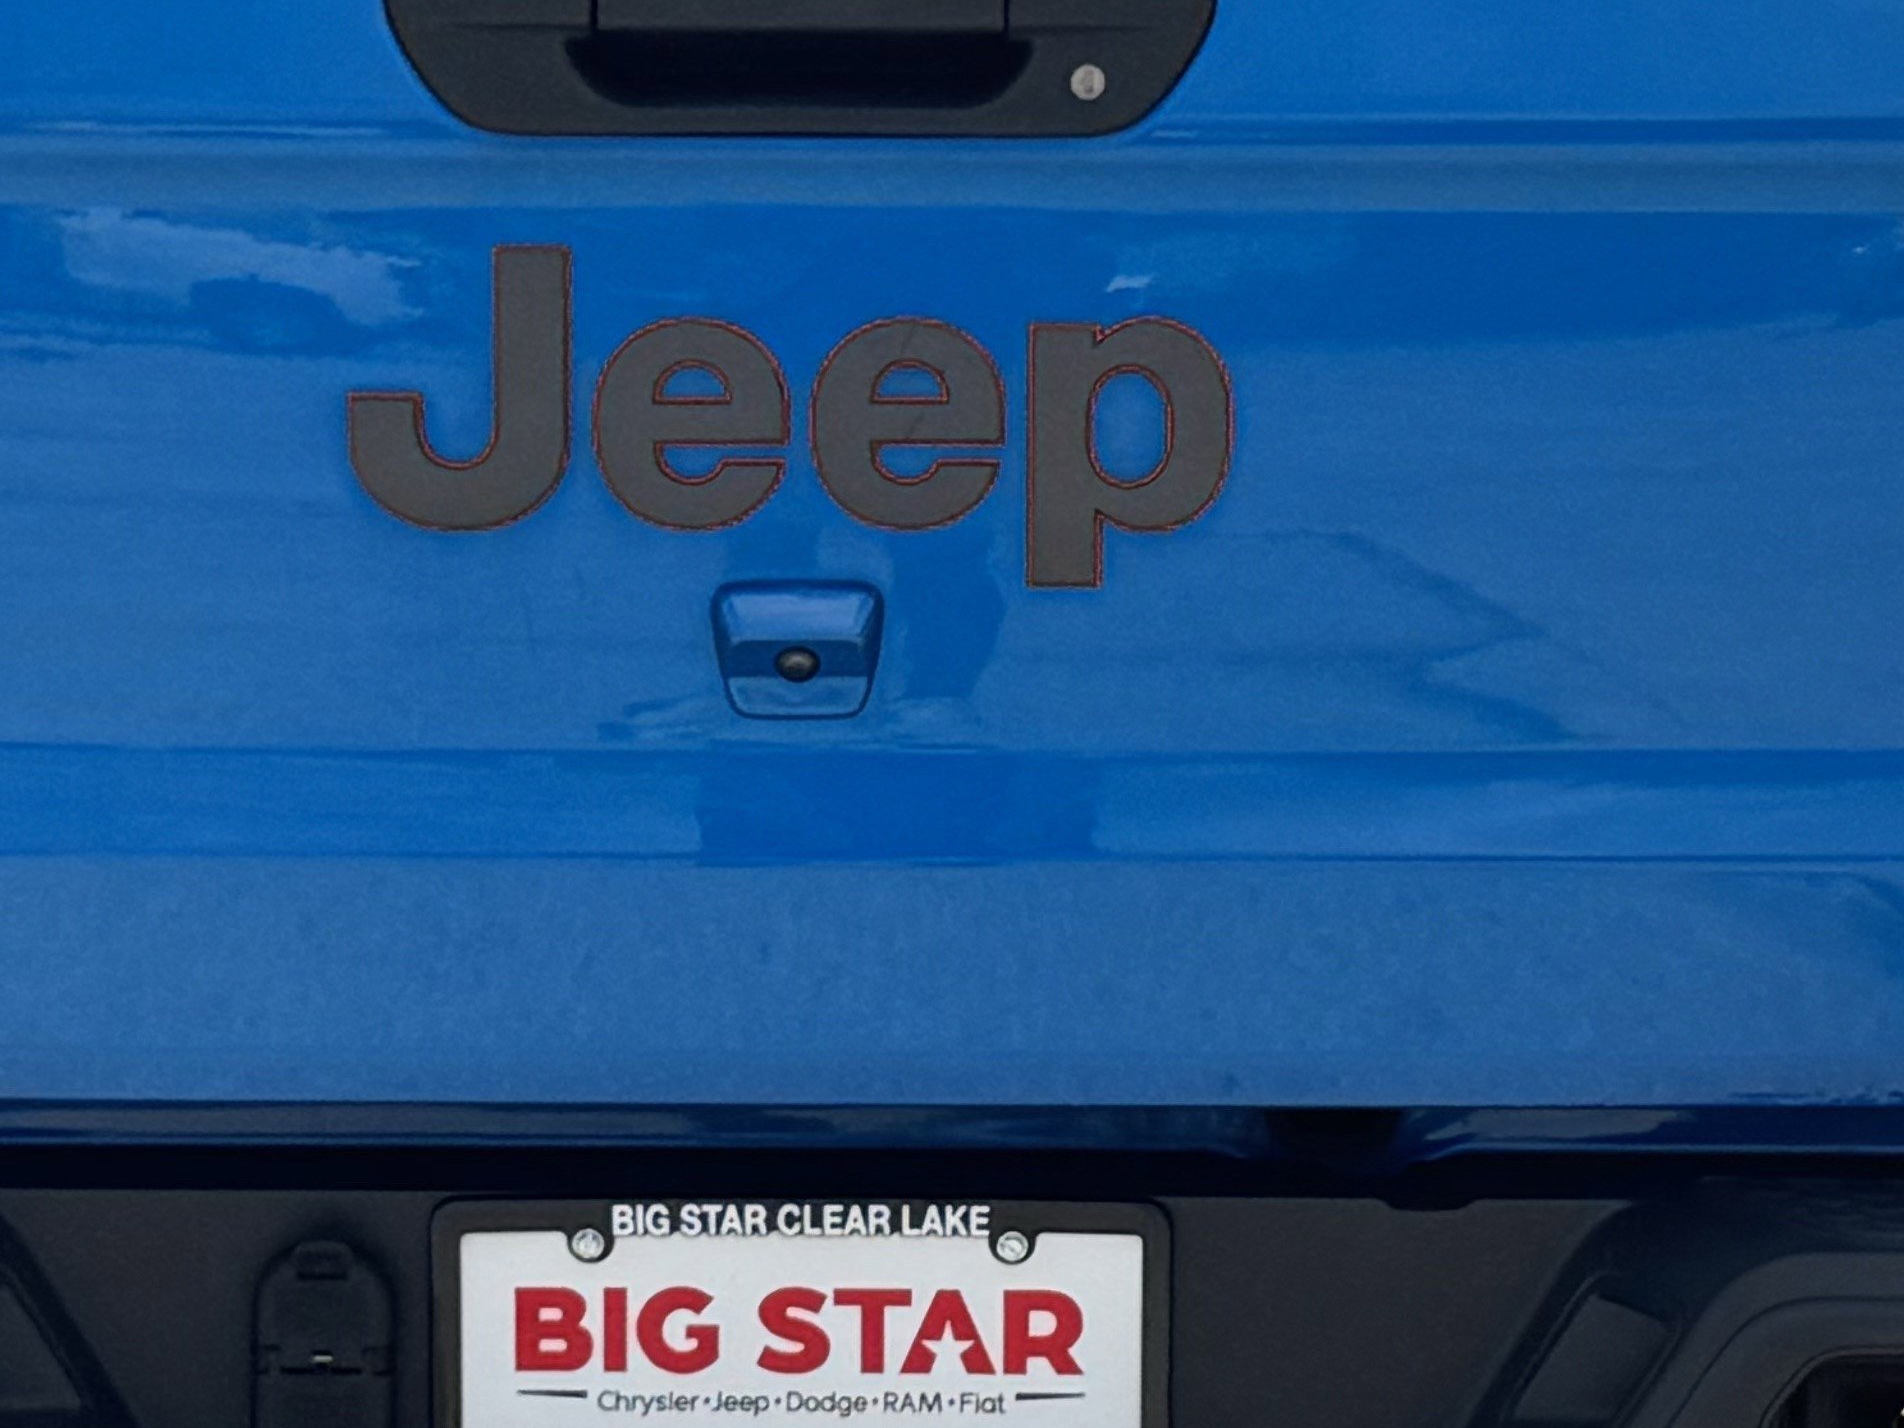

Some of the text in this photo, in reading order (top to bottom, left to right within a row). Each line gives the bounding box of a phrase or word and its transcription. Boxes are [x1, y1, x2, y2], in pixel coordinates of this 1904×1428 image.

[347, 243, 1234, 589] Jeep
[611, 1203, 991, 1237] BIG STAR CLEAR LAKE
[514, 1285, 1085, 1376] BIG STAR
[597, 1390, 701, 1417] Chrysler
[959, 1392, 1007, 1414] Fiat
